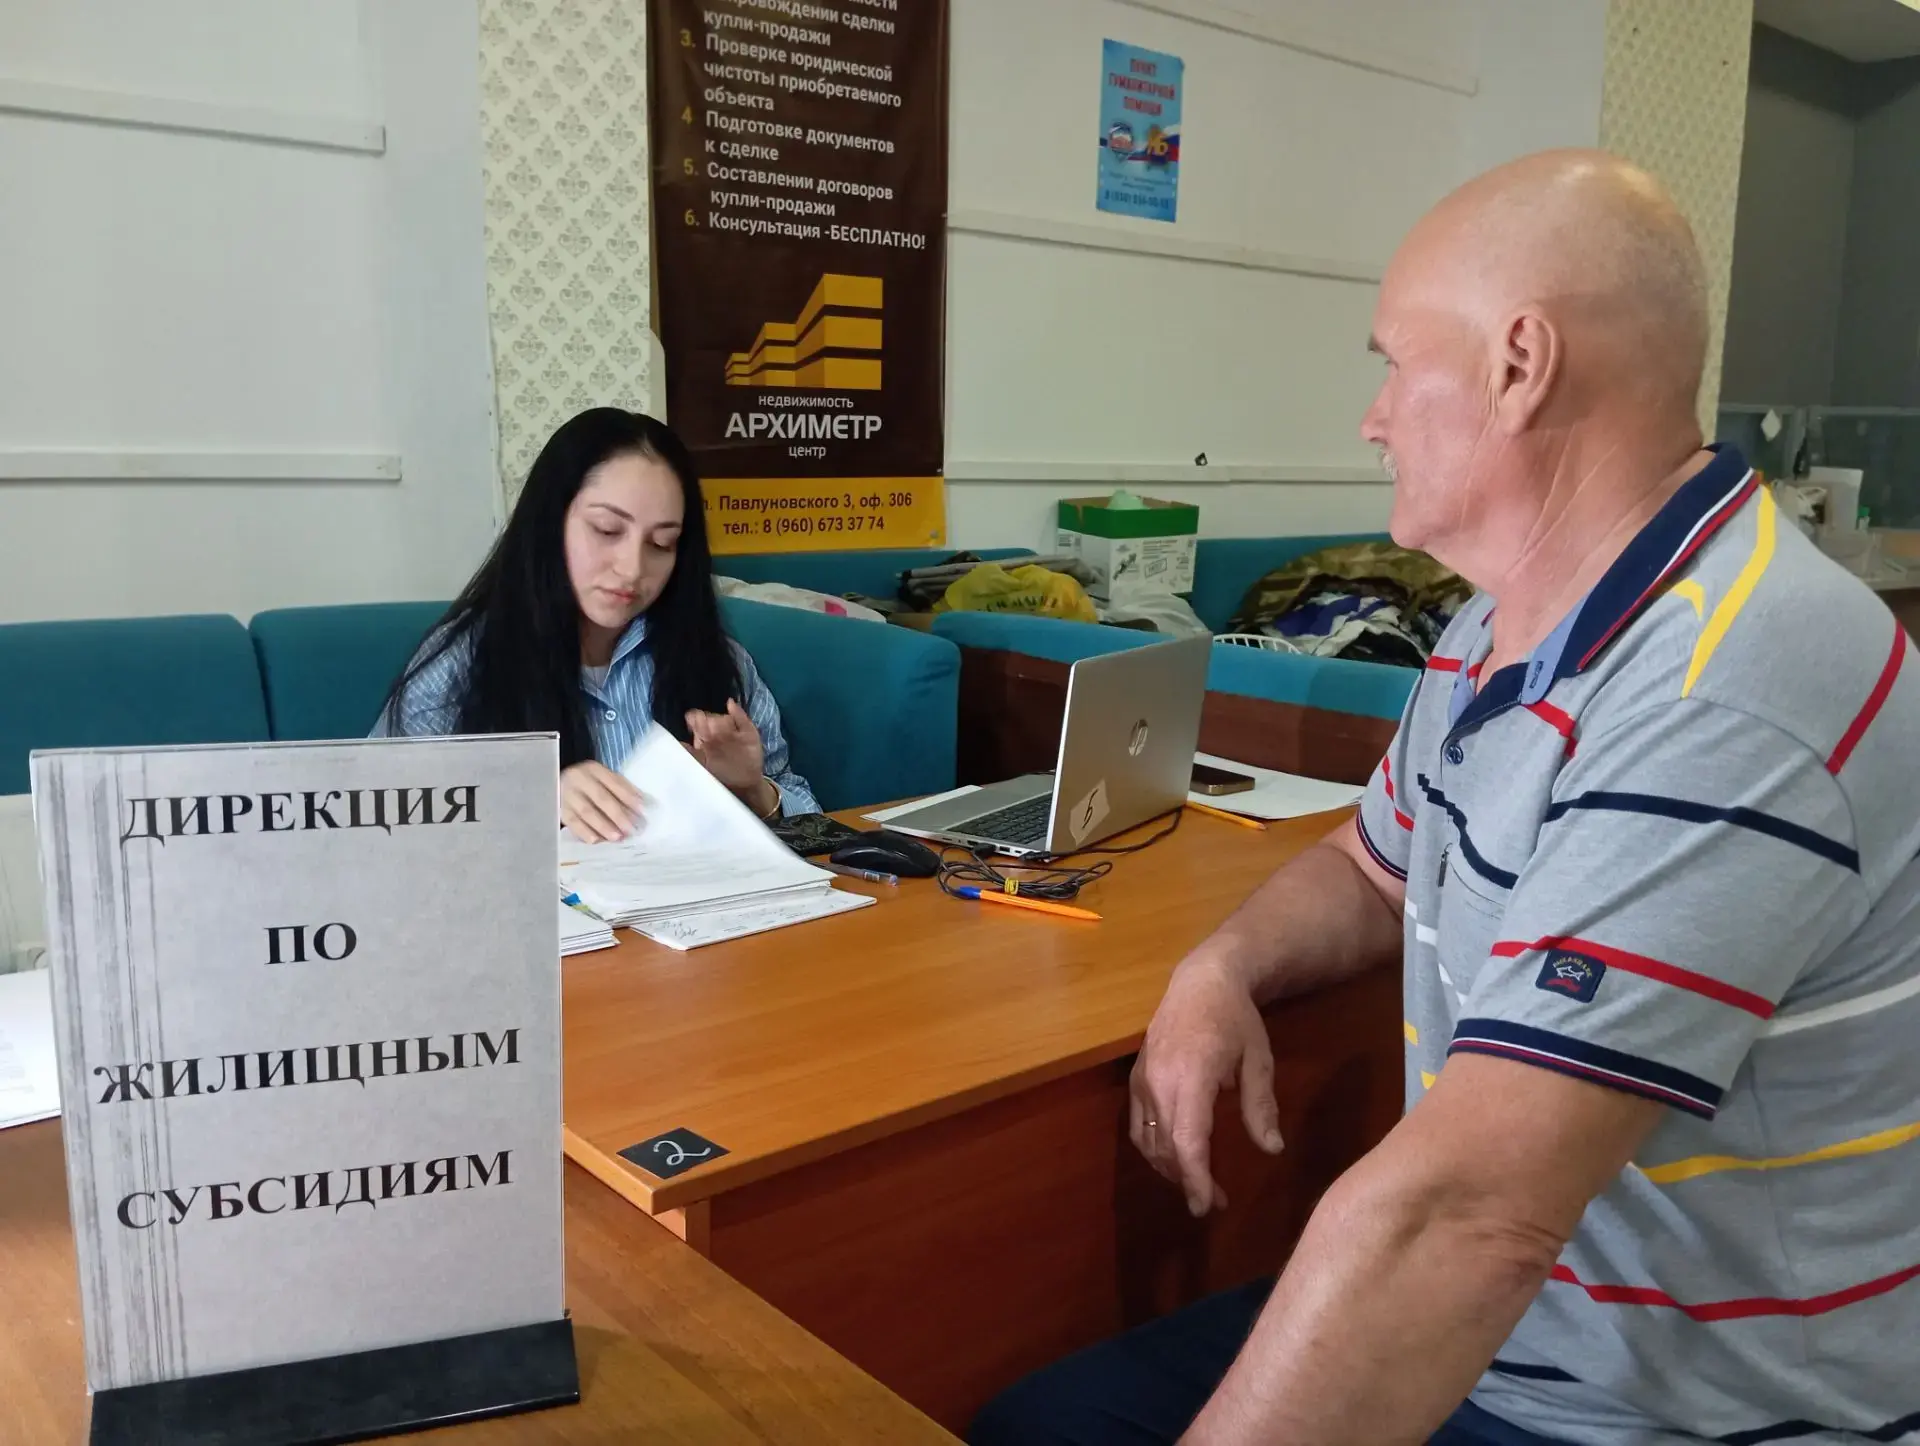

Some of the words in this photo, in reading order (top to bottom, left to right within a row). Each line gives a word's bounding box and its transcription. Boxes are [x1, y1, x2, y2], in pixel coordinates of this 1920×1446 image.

[703, 10, 832, 47] купли-продажи
[728, 0, 839, 23] ровождении
[841, 12, 896, 35] сделки
[680, 29, 696, 48] 3.
[706, 33, 787, 63] Проверке
[790, 49, 893, 82] юридической
[704, 62, 775, 86] чистоты
[779, 73, 901, 107] приобретаемого
[704, 86, 775, 111] объекта
[704, 138, 716, 154] к
[719, 139, 779, 161] сделке
[706, 110, 803, 140] Подготовке
[806, 127, 895, 154] документов
[683, 158, 699, 176] 5.
[707, 162, 814, 190] Составлении
[817, 178, 893, 201] договоров
[710, 190, 836, 217] купли-продажи
[684, 209, 700, 227] 6.
[708, 211, 821, 240] Консультация
[824, 224, 926, 250] -БЕСПЛАТНО!
[758, 394, 854, 408] недвижимость
[724, 411, 883, 440] АРХИМЕТР
[788, 445, 827, 460] центр
[719, 493, 839, 513] Павлуновского
[843, 493, 855, 510] 3,
[859, 492, 884, 511] оф.
[888, 492, 912, 507] 306
[723, 520, 758, 536] тел.:
[763, 519, 772, 533] 8
[776, 516, 814, 537] (960)
[818, 517, 843, 532] 673
[847, 516, 864, 531] 37
[867, 515, 885, 531] 74
[119, 783, 482, 849] ДИРЕКЦИЯ
[264, 921, 359, 966] ПО
[93, 1028, 522, 1105] ЖИЛИЩНЫМ
[652, 1139, 712, 1167] 2
[116, 1149, 515, 1231] СУБСИДИЯМ
